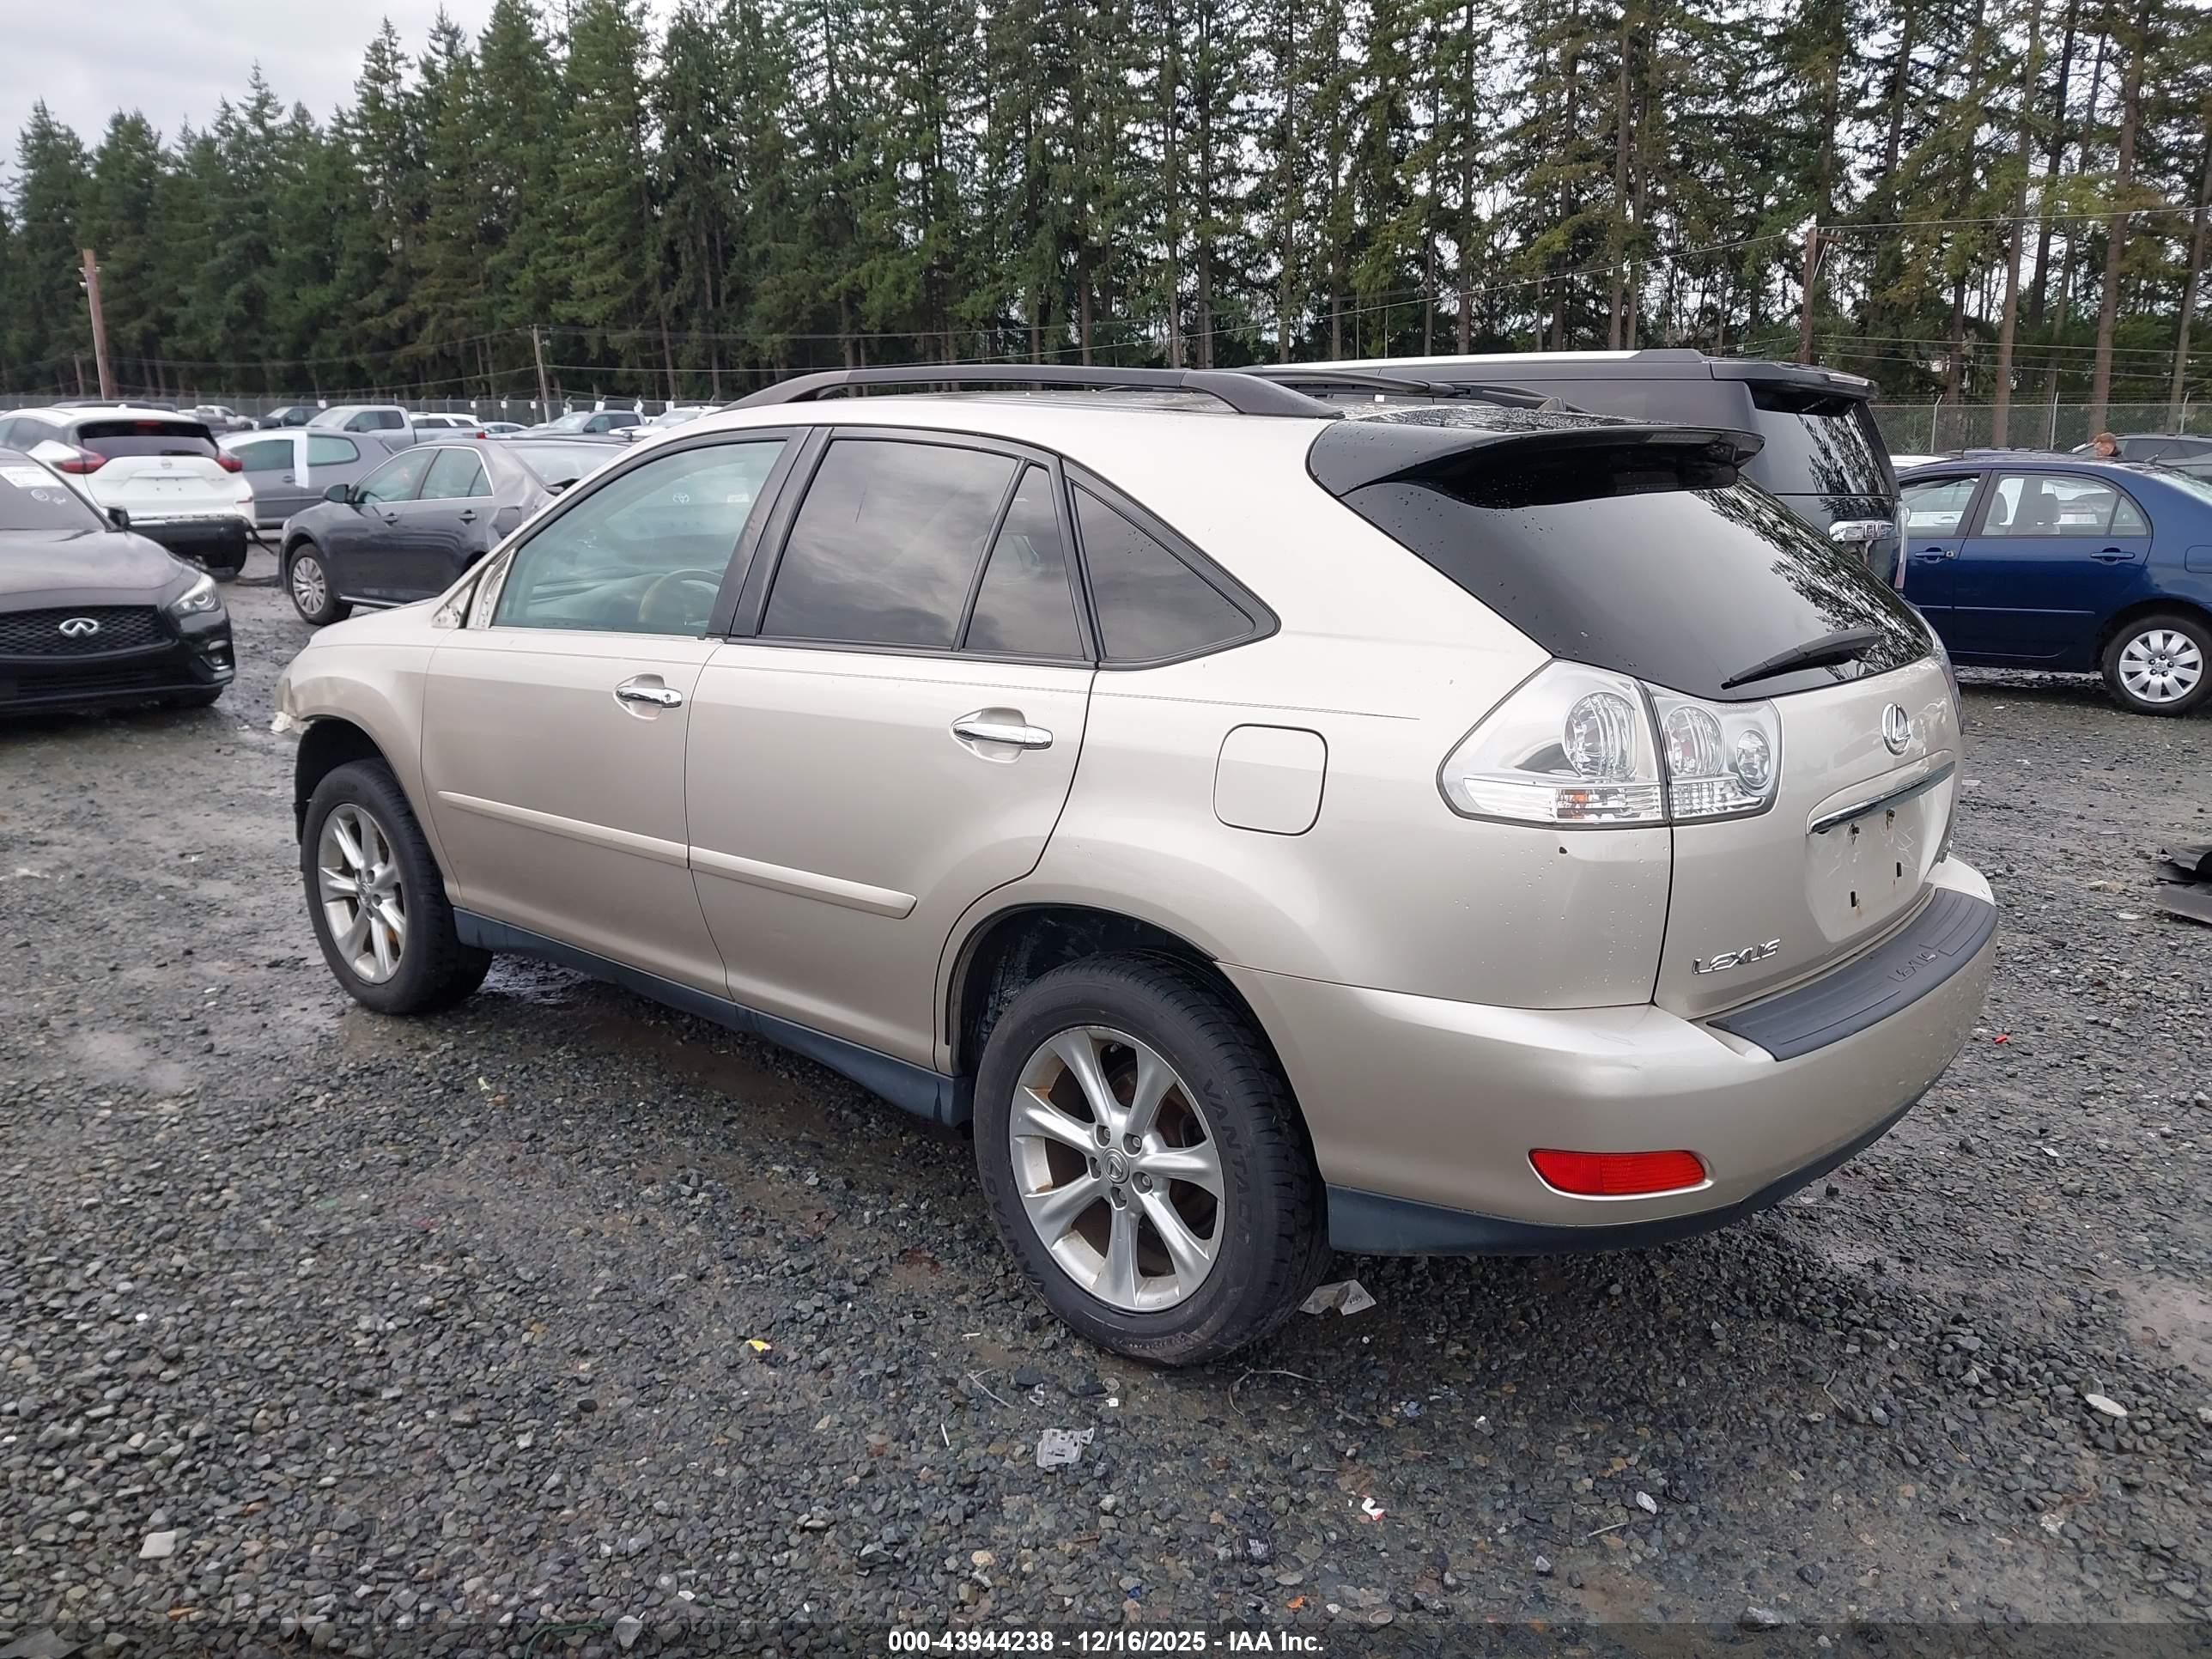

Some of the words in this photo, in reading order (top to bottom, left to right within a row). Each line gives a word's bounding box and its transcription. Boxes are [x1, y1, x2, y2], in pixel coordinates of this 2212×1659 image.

[1863, 522, 1895, 538] GMC
[1692, 938, 1781, 975] LEXUS
[1887, 951, 1938, 982] LEXUS
